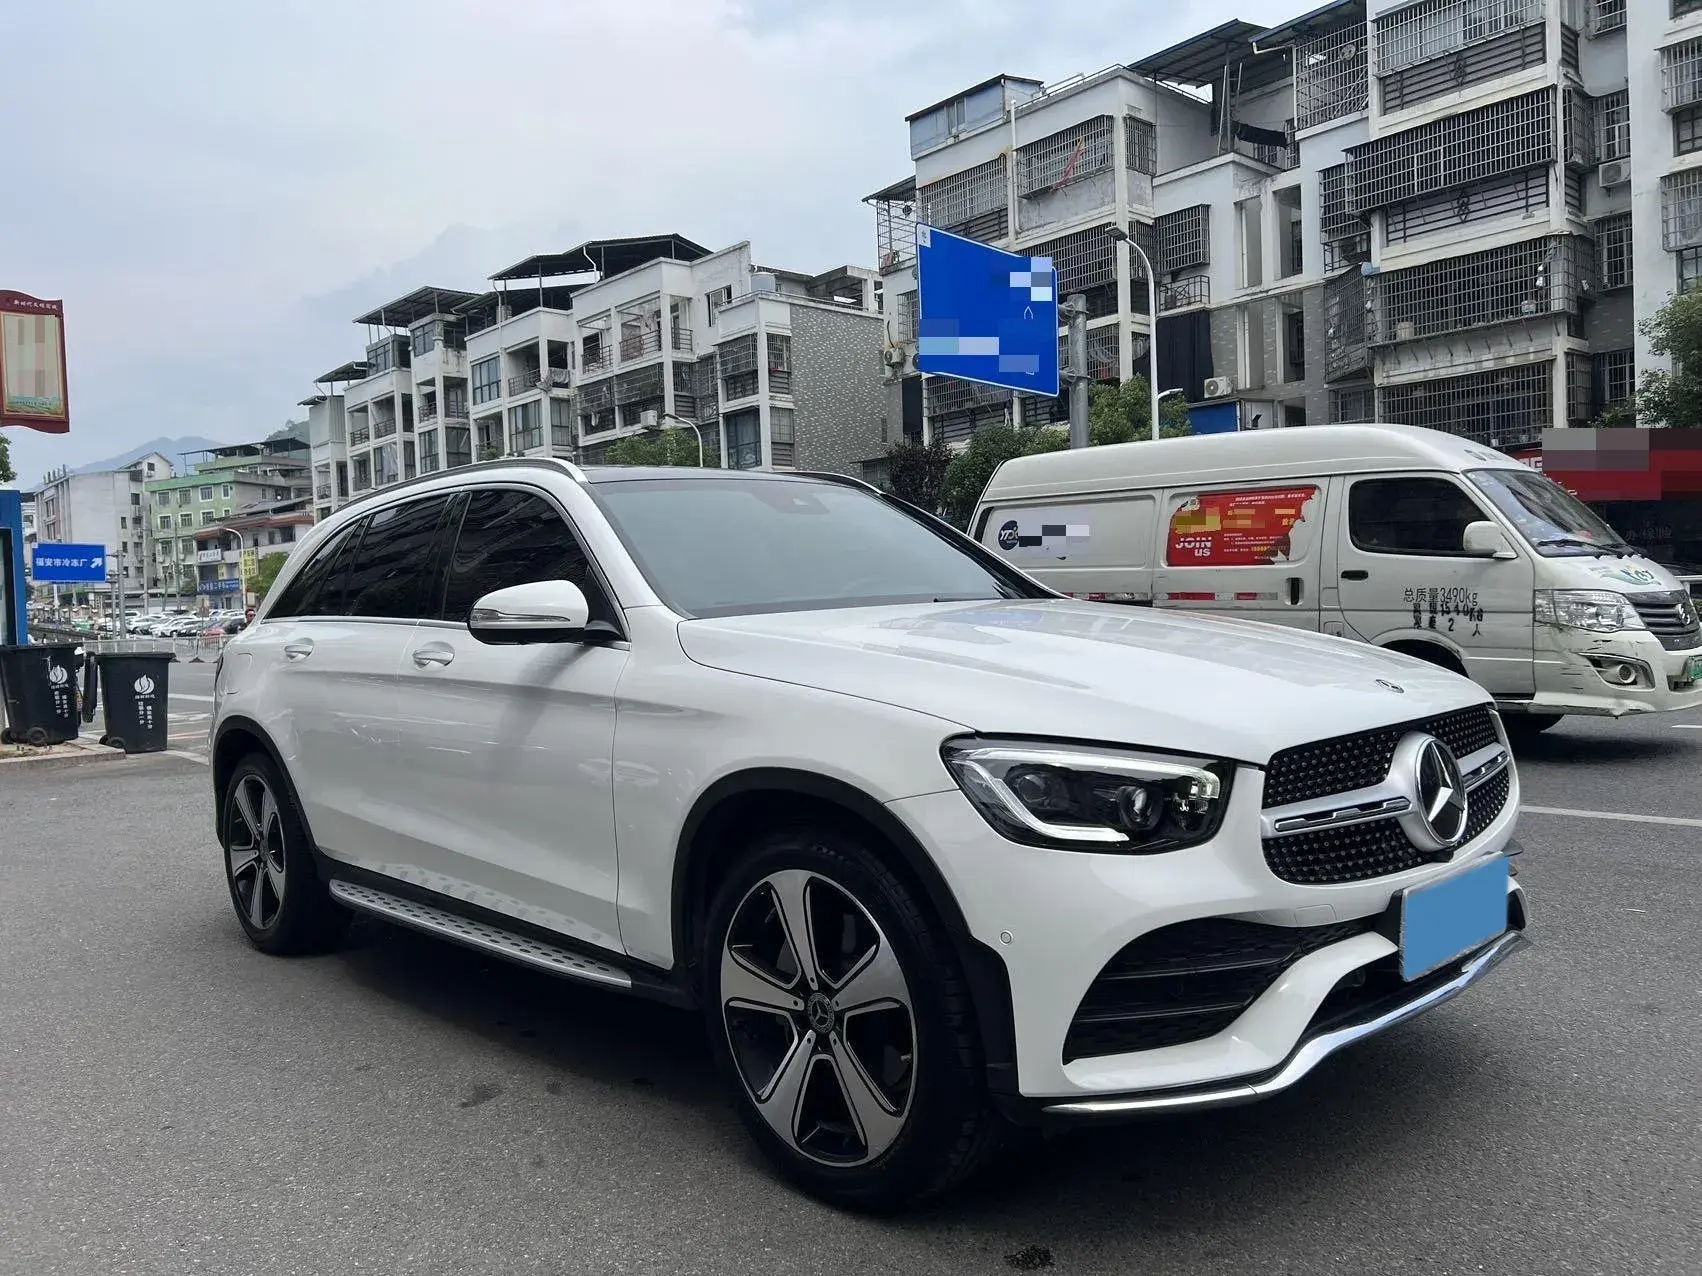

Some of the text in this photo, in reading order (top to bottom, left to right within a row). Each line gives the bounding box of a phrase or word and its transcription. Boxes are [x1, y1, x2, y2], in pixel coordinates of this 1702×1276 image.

[1175, 536, 1212, 549] JOIN
[35, 557, 88, 567] 福安市冷冻厂
